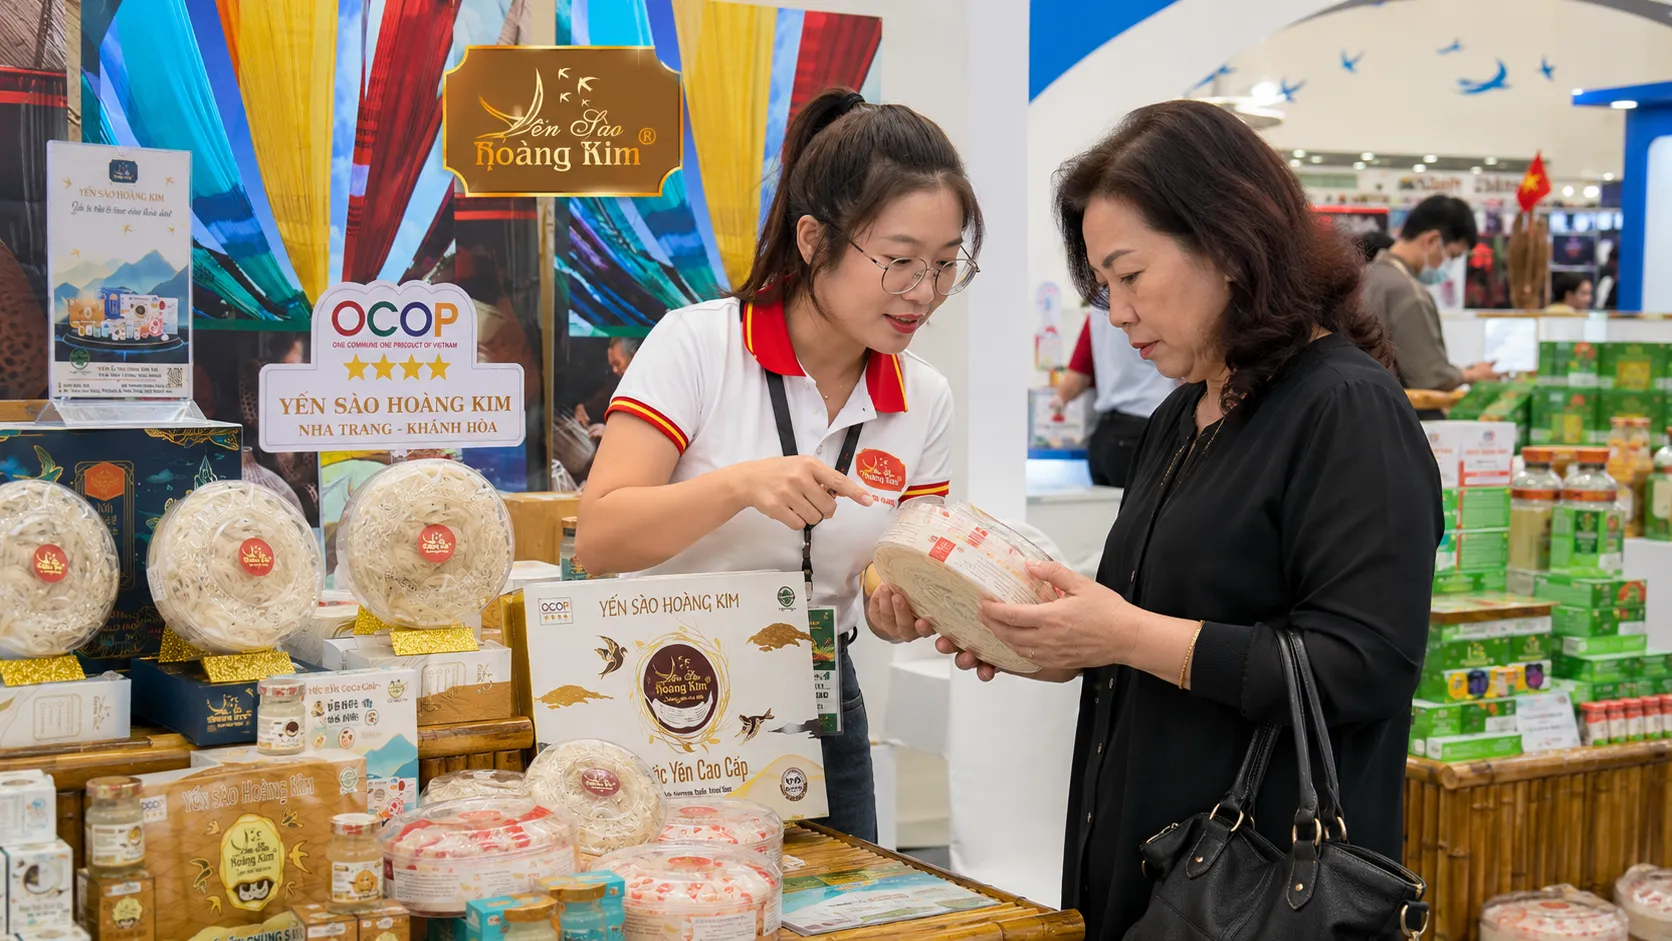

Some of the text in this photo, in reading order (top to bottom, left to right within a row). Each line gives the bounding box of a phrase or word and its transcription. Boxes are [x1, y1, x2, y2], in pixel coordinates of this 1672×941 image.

[474, 139, 571, 172] Hoàng
[149, 193, 165, 202] KIM
[331, 300, 459, 338] OCOP
[279, 391, 512, 415] YẾN SÀO HOÀNG KIM
[298, 423, 334, 437] NHA
[338, 422, 393, 436] TRANG
[407, 419, 462, 435] KHÁNH
[467, 418, 497, 433] HÒA
[541, 601, 570, 613] OCOP
[599, 591, 739, 617] YẾN SÀO HOÀNG KIM
[697, 759, 721, 780] Cao
